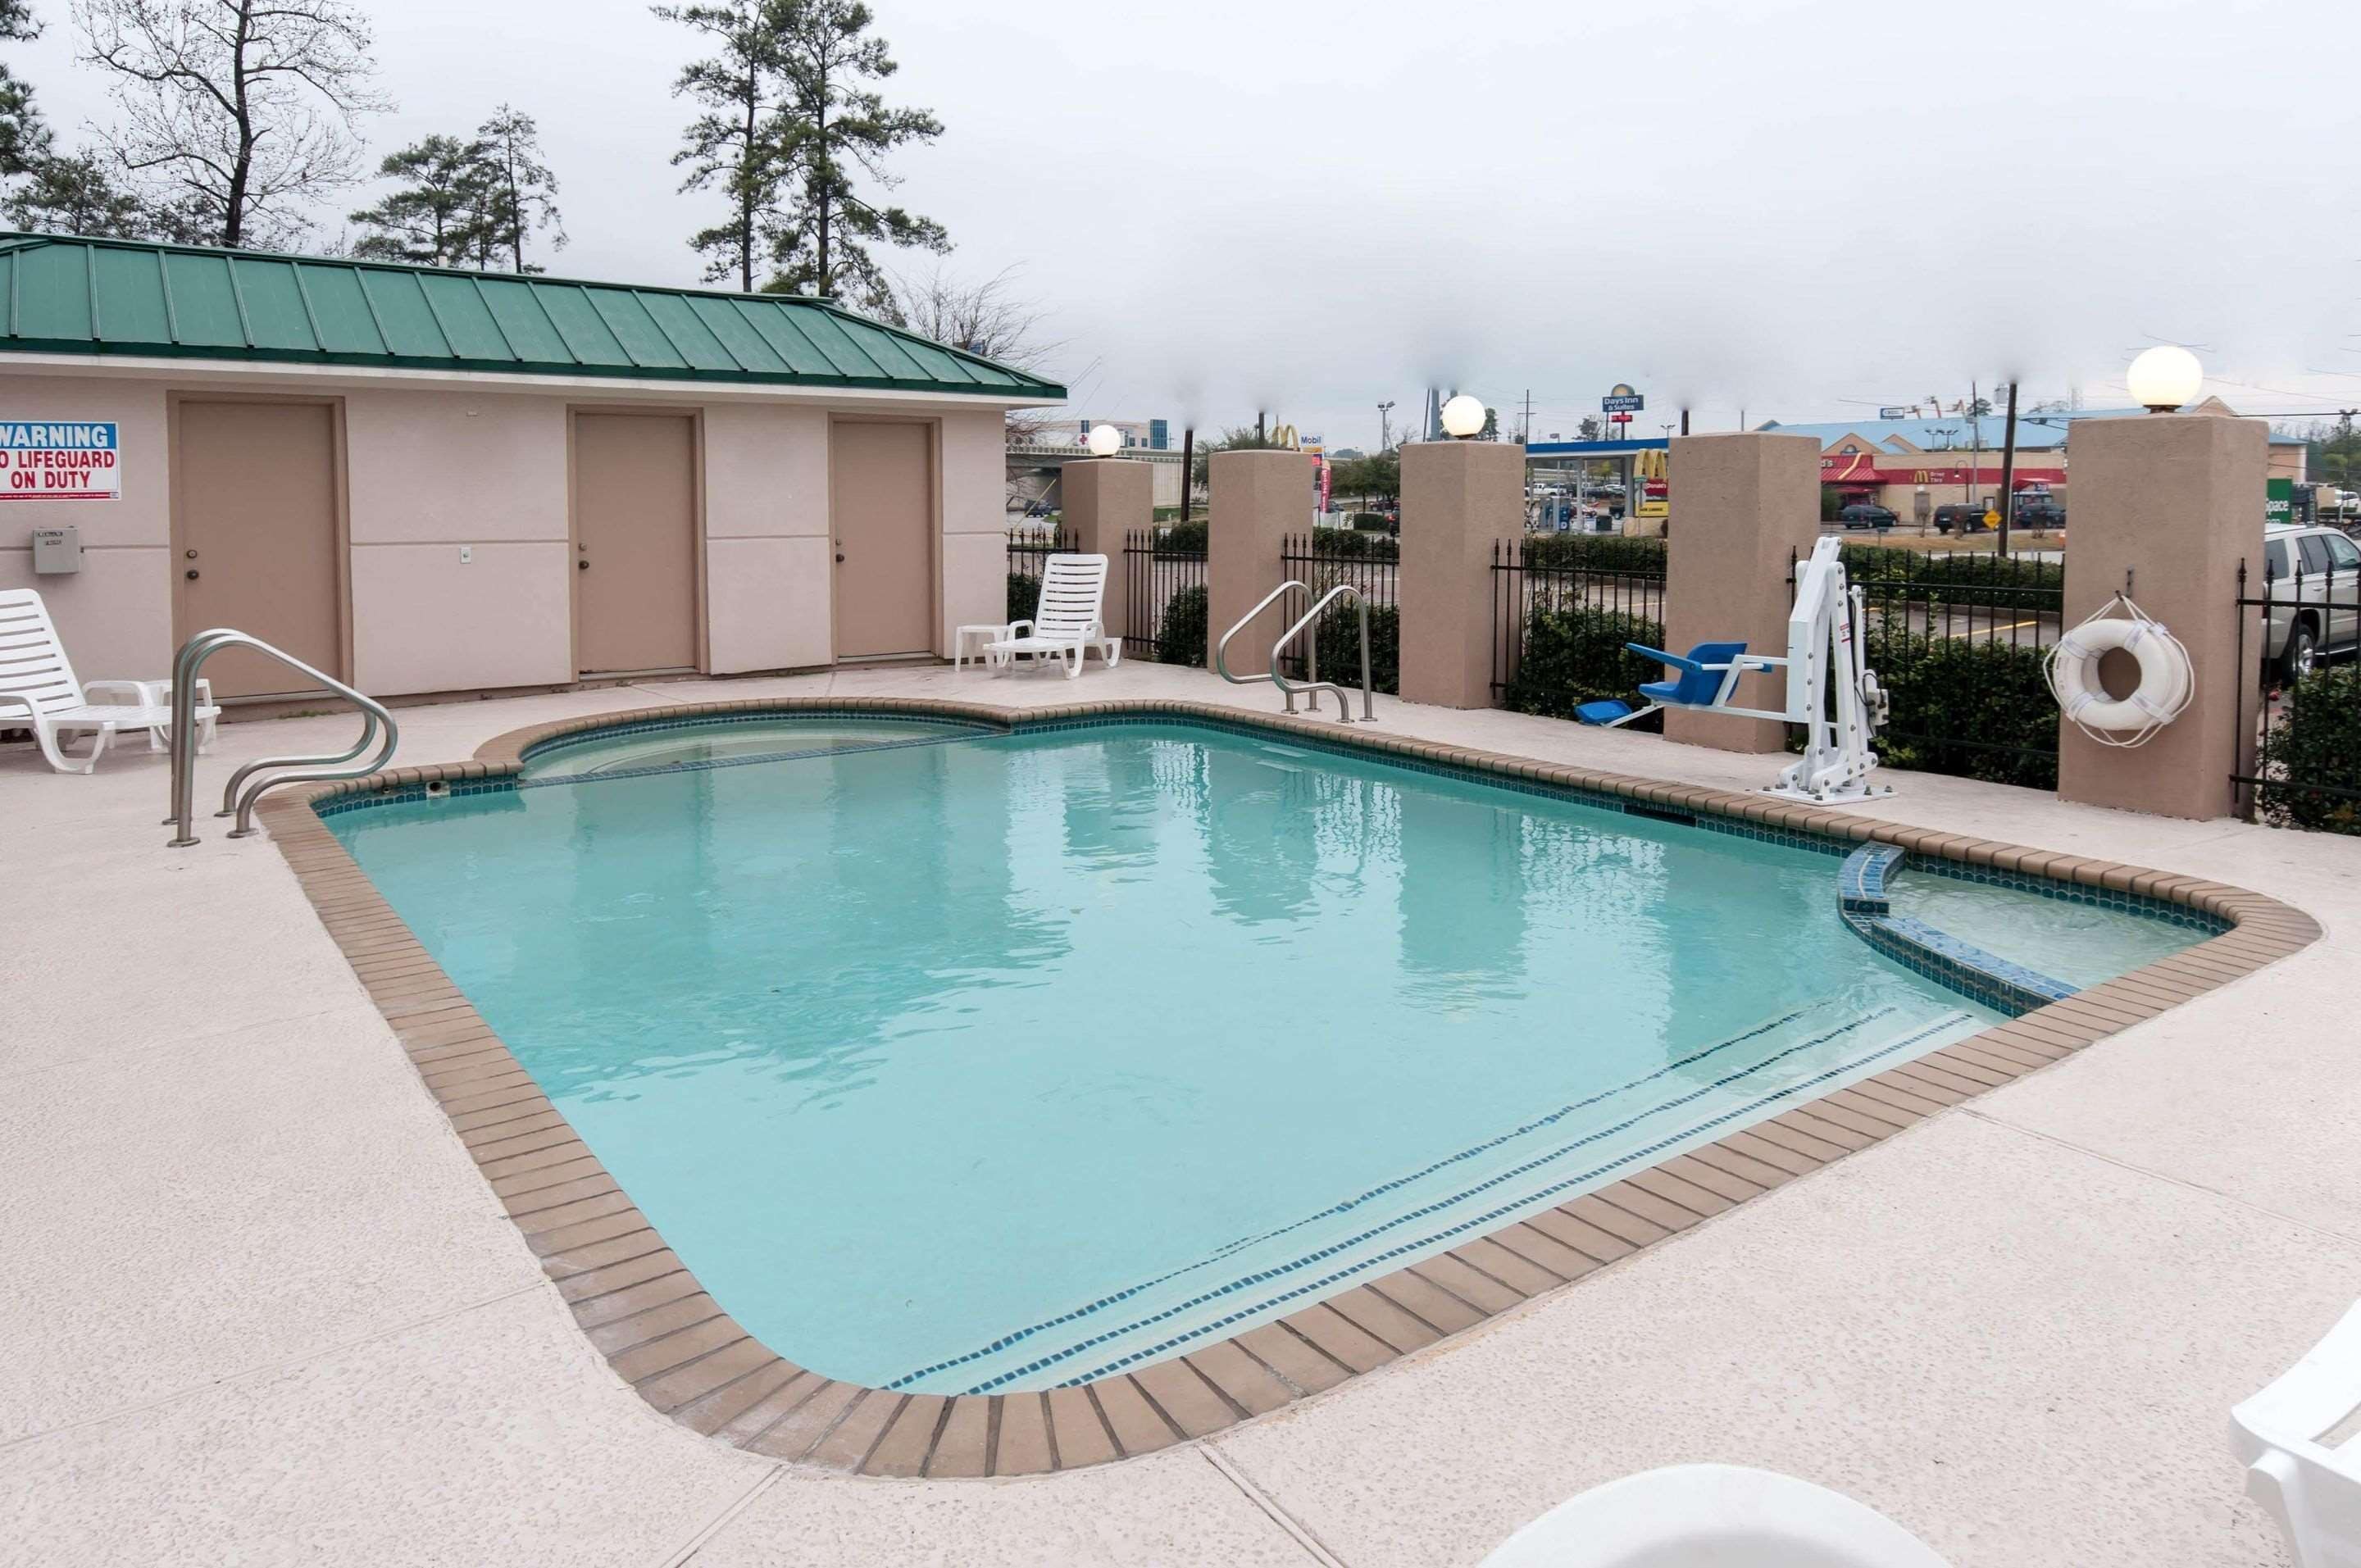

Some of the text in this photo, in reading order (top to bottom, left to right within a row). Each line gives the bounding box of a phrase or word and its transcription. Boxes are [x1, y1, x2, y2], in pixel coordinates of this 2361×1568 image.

[0, 425, 107, 447] WARNING
[1301, 436, 1322, 444] Mobil
[0, 451, 115, 468] O LIFEGUARD
[11, 471, 91, 489] ON DUTY
